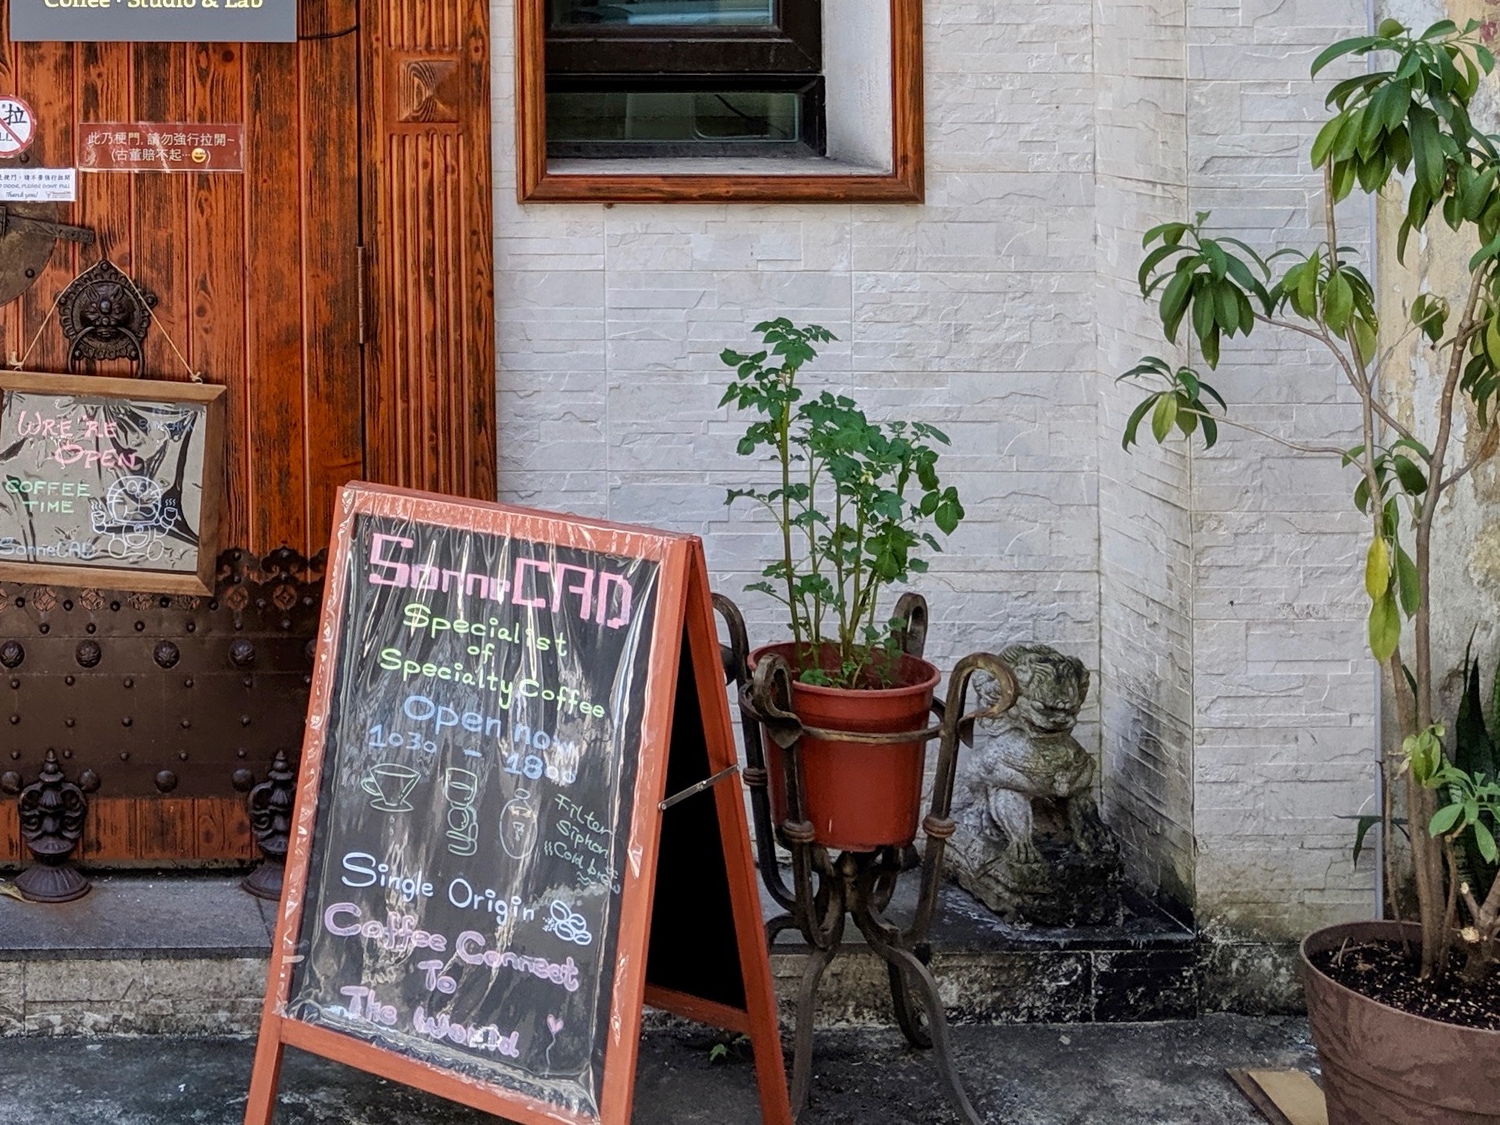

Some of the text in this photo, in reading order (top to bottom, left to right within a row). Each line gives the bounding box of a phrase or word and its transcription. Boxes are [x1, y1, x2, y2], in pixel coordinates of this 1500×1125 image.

[3, 103, 27, 126] 拉
[5, 478, 91, 497] COFFEE
[22, 500, 75, 515] TIME
[402, 603, 568, 657] Specialist
[467, 643, 495, 664] of
[380, 648, 606, 718] Specialty Coffee
[403, 695, 502, 737] Open
[368, 724, 438, 754] 1030
[554, 793, 615, 835] Filter
[553, 841, 583, 869] Cold
[555, 819, 609, 859] Siphon
[341, 852, 535, 925] Single Origin
[324, 902, 448, 952] Coffee
[417, 959, 457, 995] To
[340, 985, 398, 1026] The
